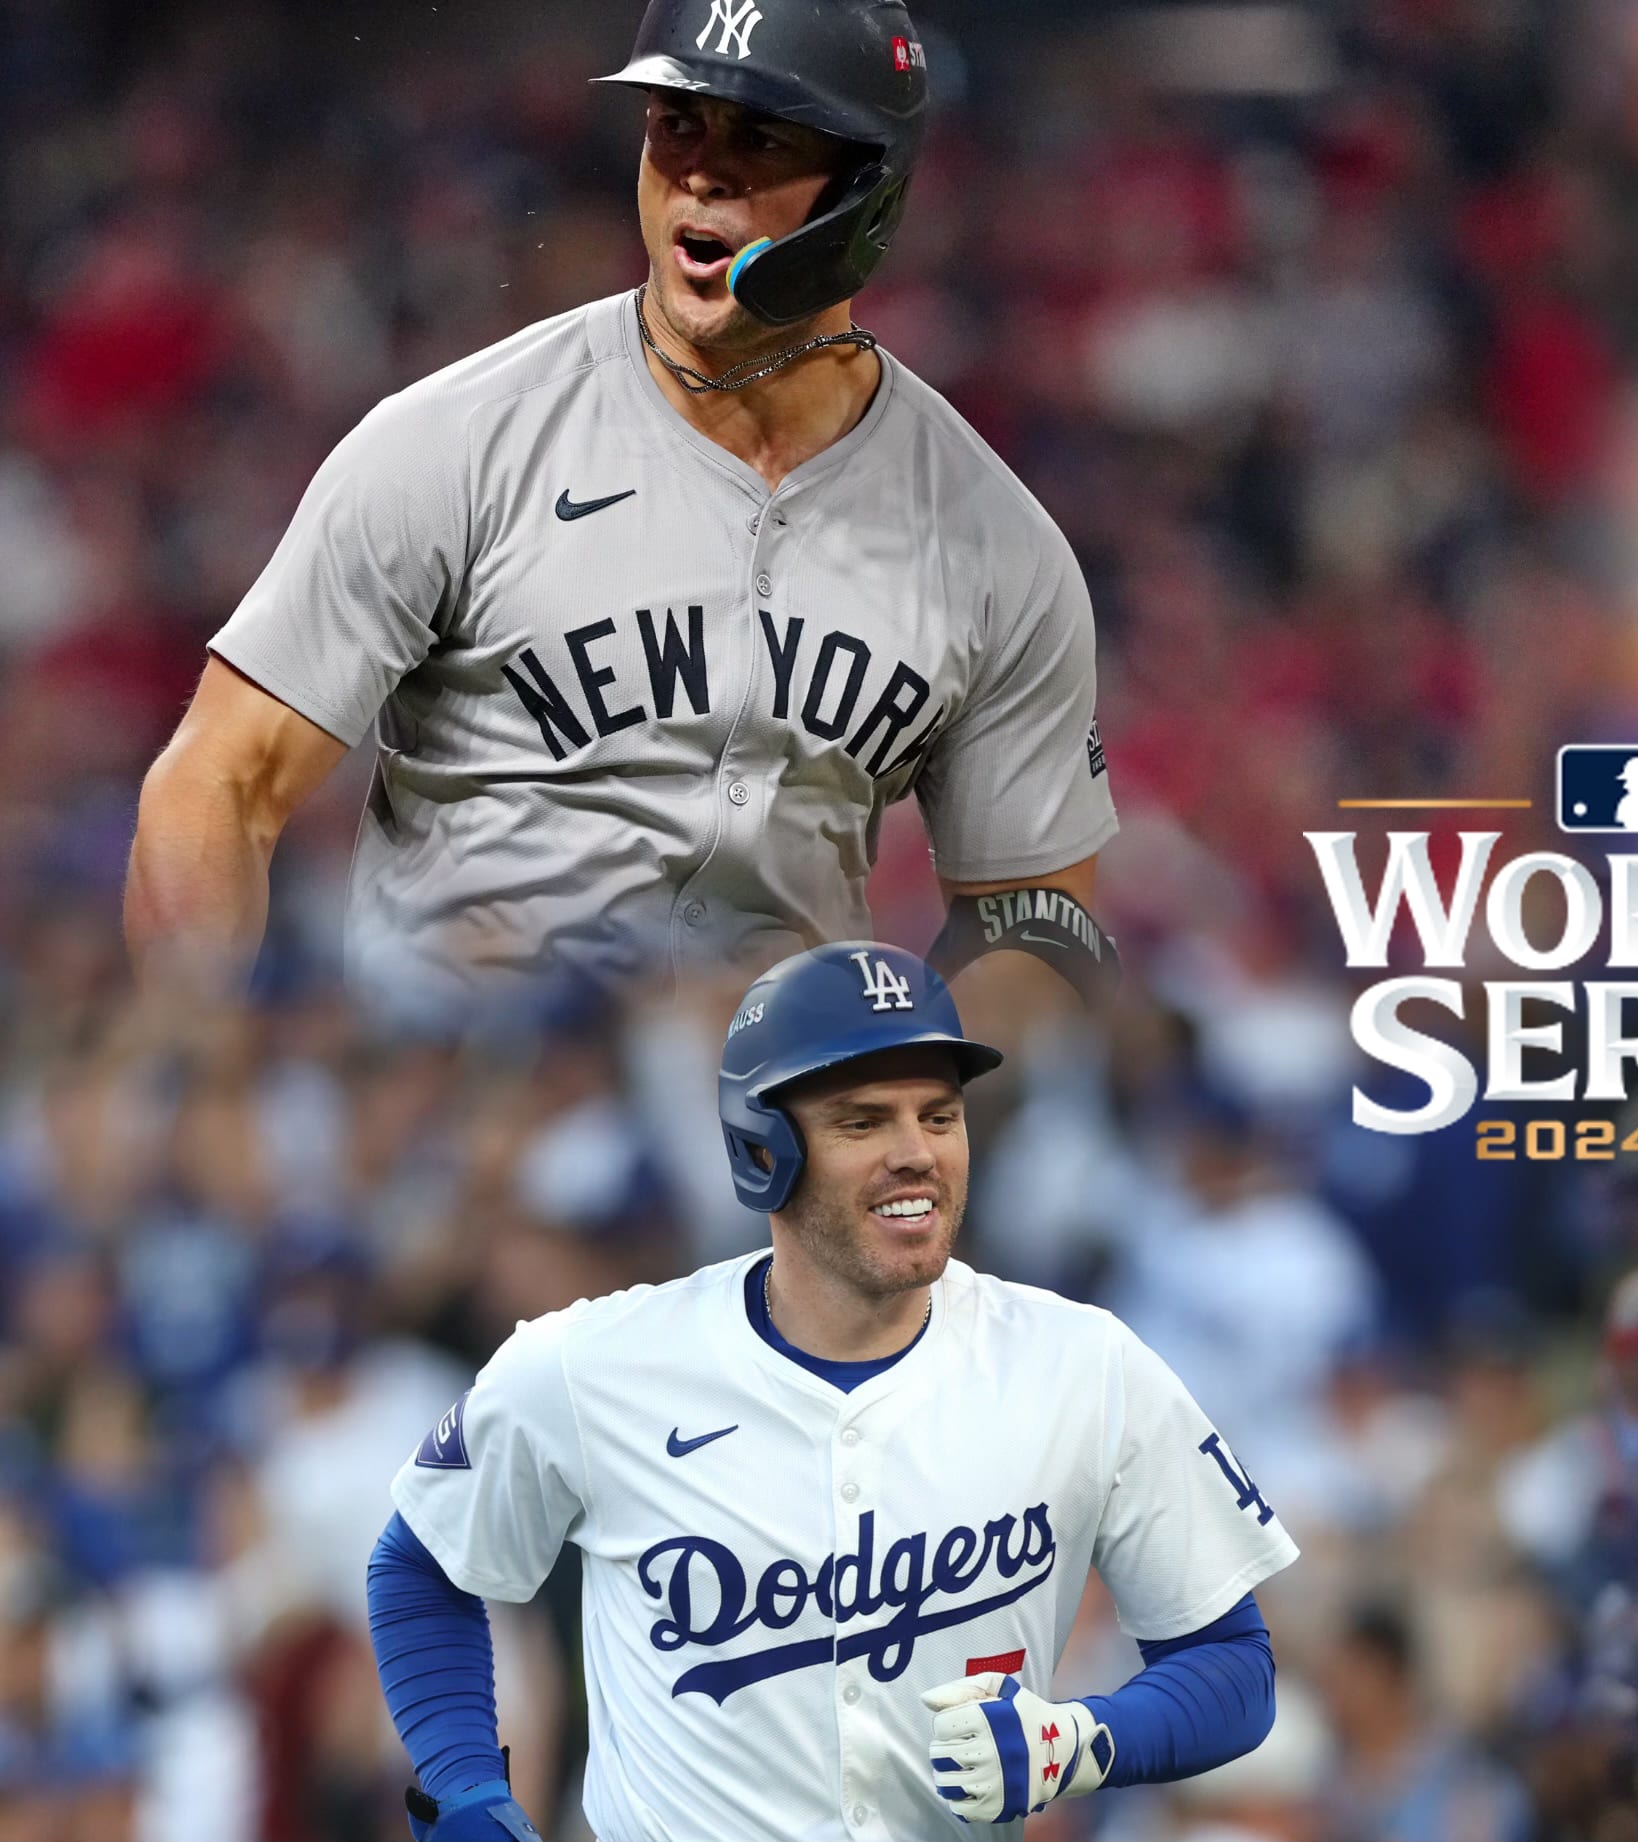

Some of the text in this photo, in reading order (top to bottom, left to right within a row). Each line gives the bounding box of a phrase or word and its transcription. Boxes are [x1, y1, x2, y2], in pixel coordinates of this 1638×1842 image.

[501, 606, 711, 762] NEW
[850, 951, 914, 1012] LA
[977, 890, 1101, 963] STANTON
[637, 1502, 1056, 1683] Dodgers
